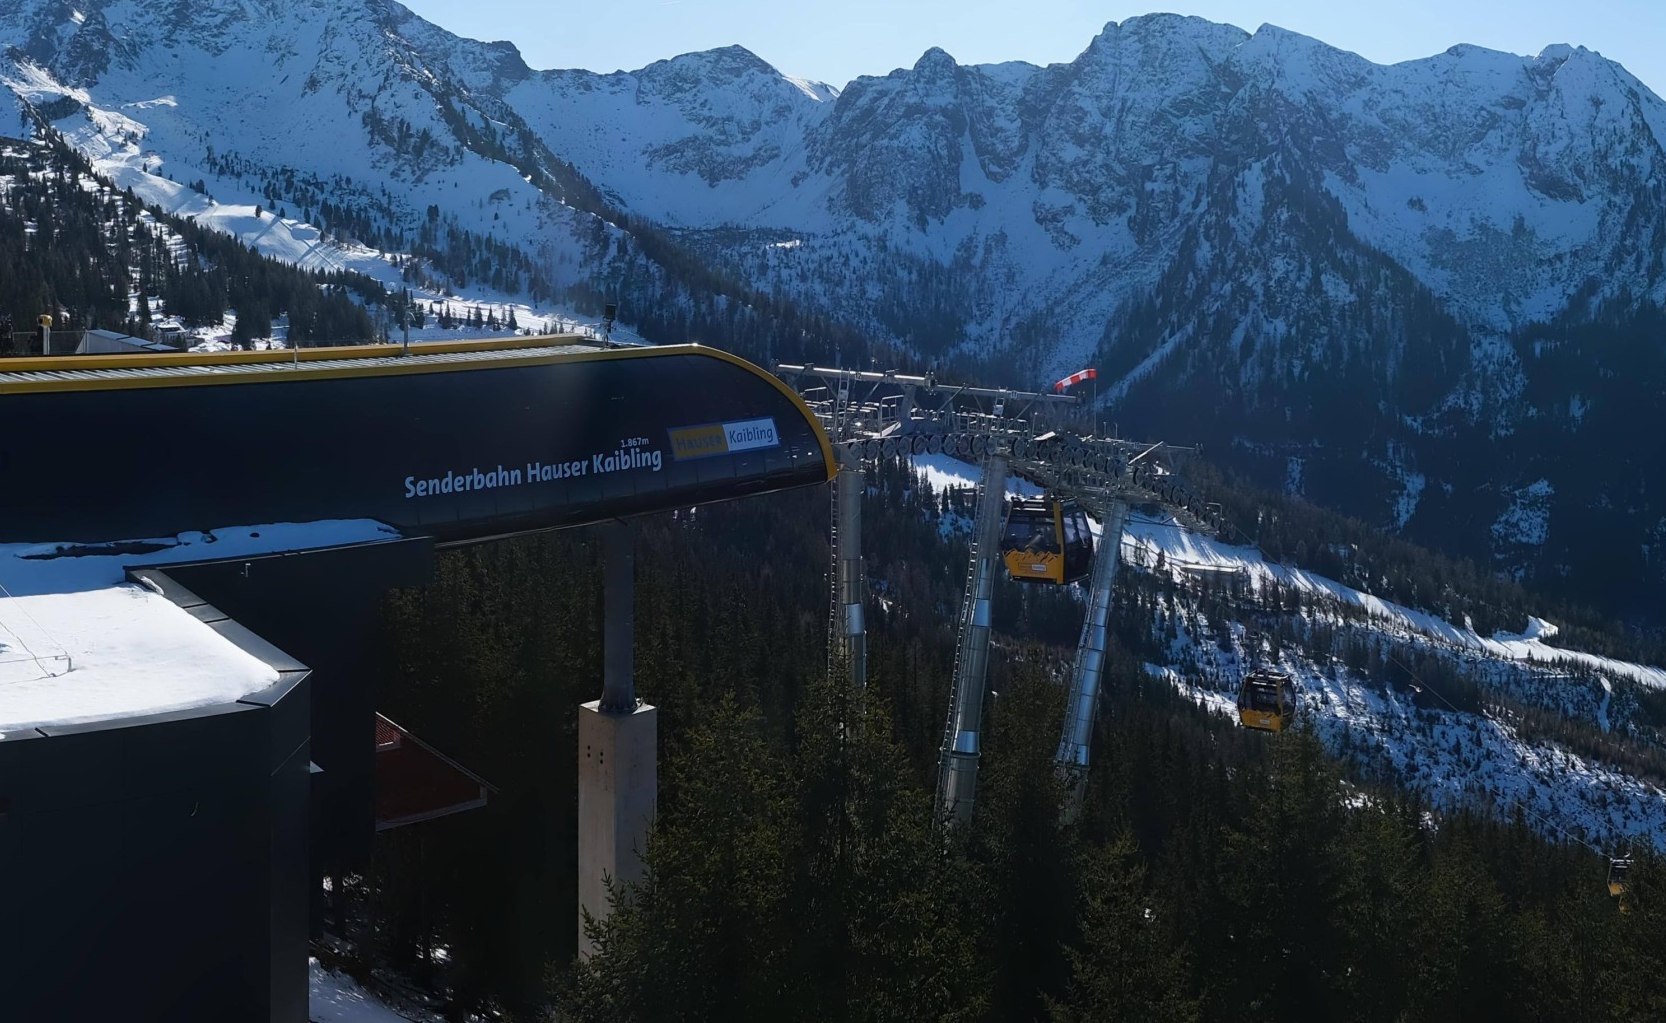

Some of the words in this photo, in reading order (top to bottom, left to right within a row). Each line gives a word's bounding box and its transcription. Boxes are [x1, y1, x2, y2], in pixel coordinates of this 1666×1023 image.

[729, 424, 775, 444] Kaibling
[404, 464, 522, 499] Senderbahn
[526, 457, 589, 483] Hauser
[592, 447, 663, 473] Kaibling
